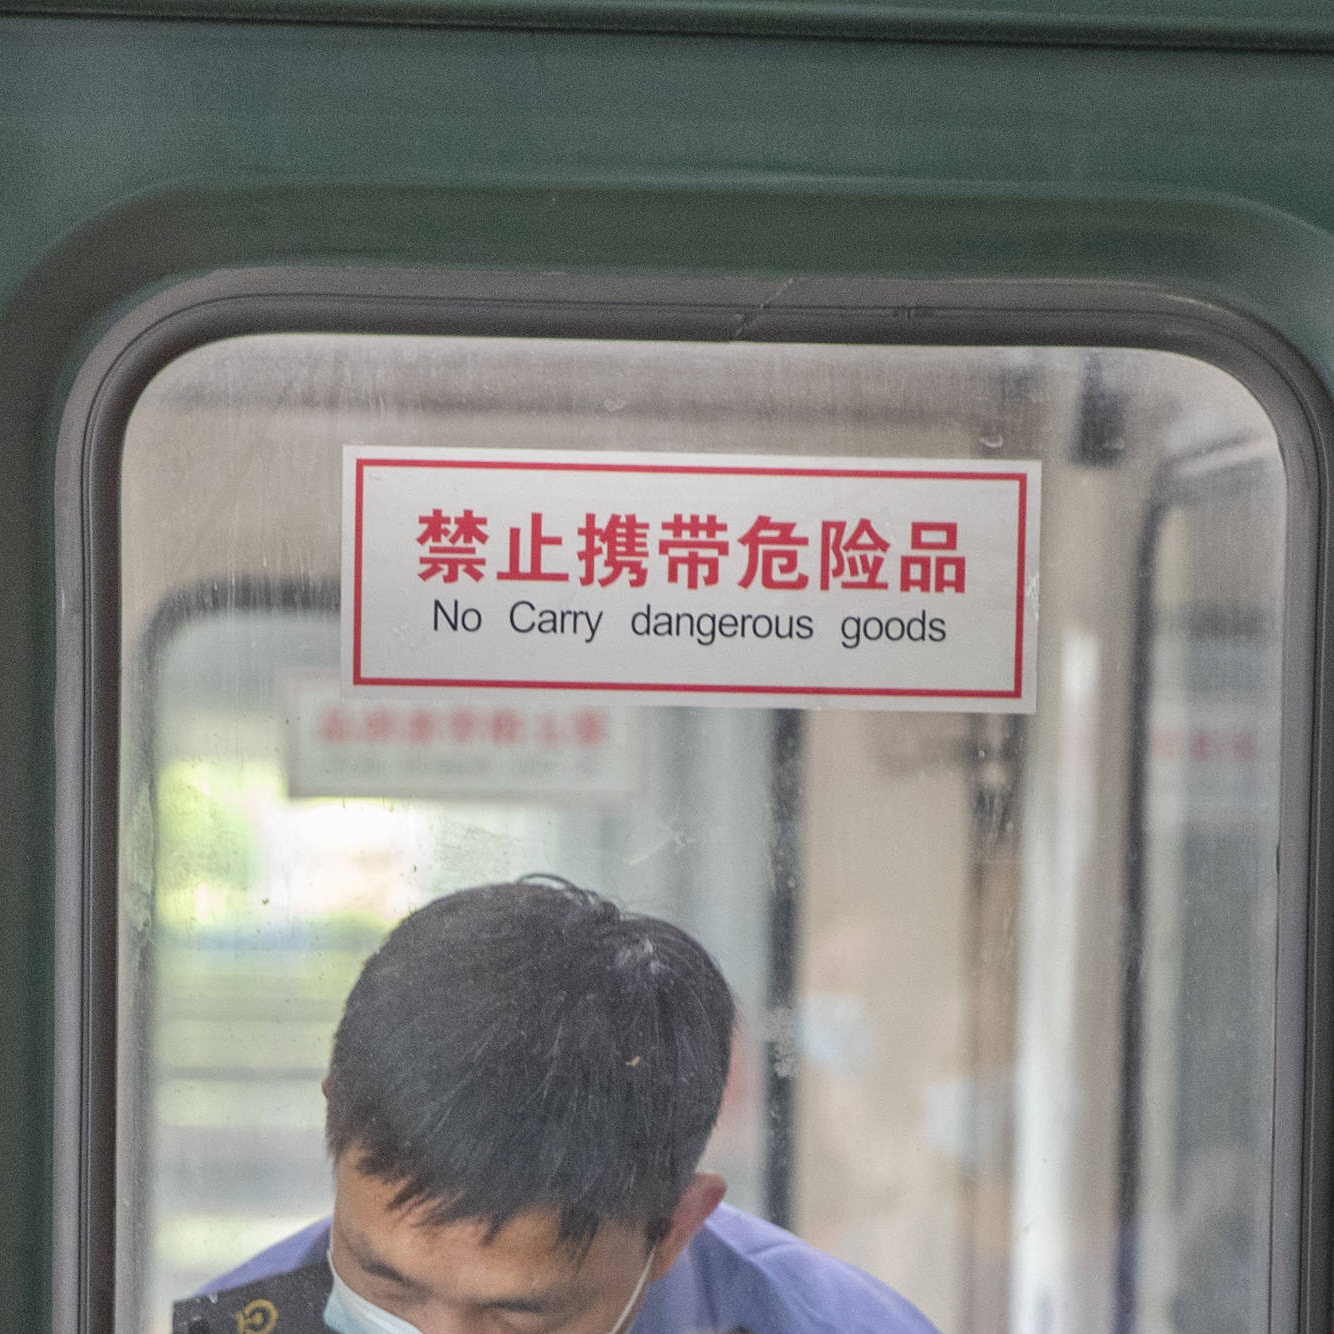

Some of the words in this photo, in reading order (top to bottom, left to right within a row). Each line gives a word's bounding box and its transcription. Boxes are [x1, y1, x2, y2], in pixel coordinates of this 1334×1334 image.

[417, 509, 967, 594] 禁止携带危险品
[433, 599, 482, 632] No
[509, 600, 603, 643] Carry
[631, 604, 814, 646] dangerous
[841, 610, 947, 649] goods
